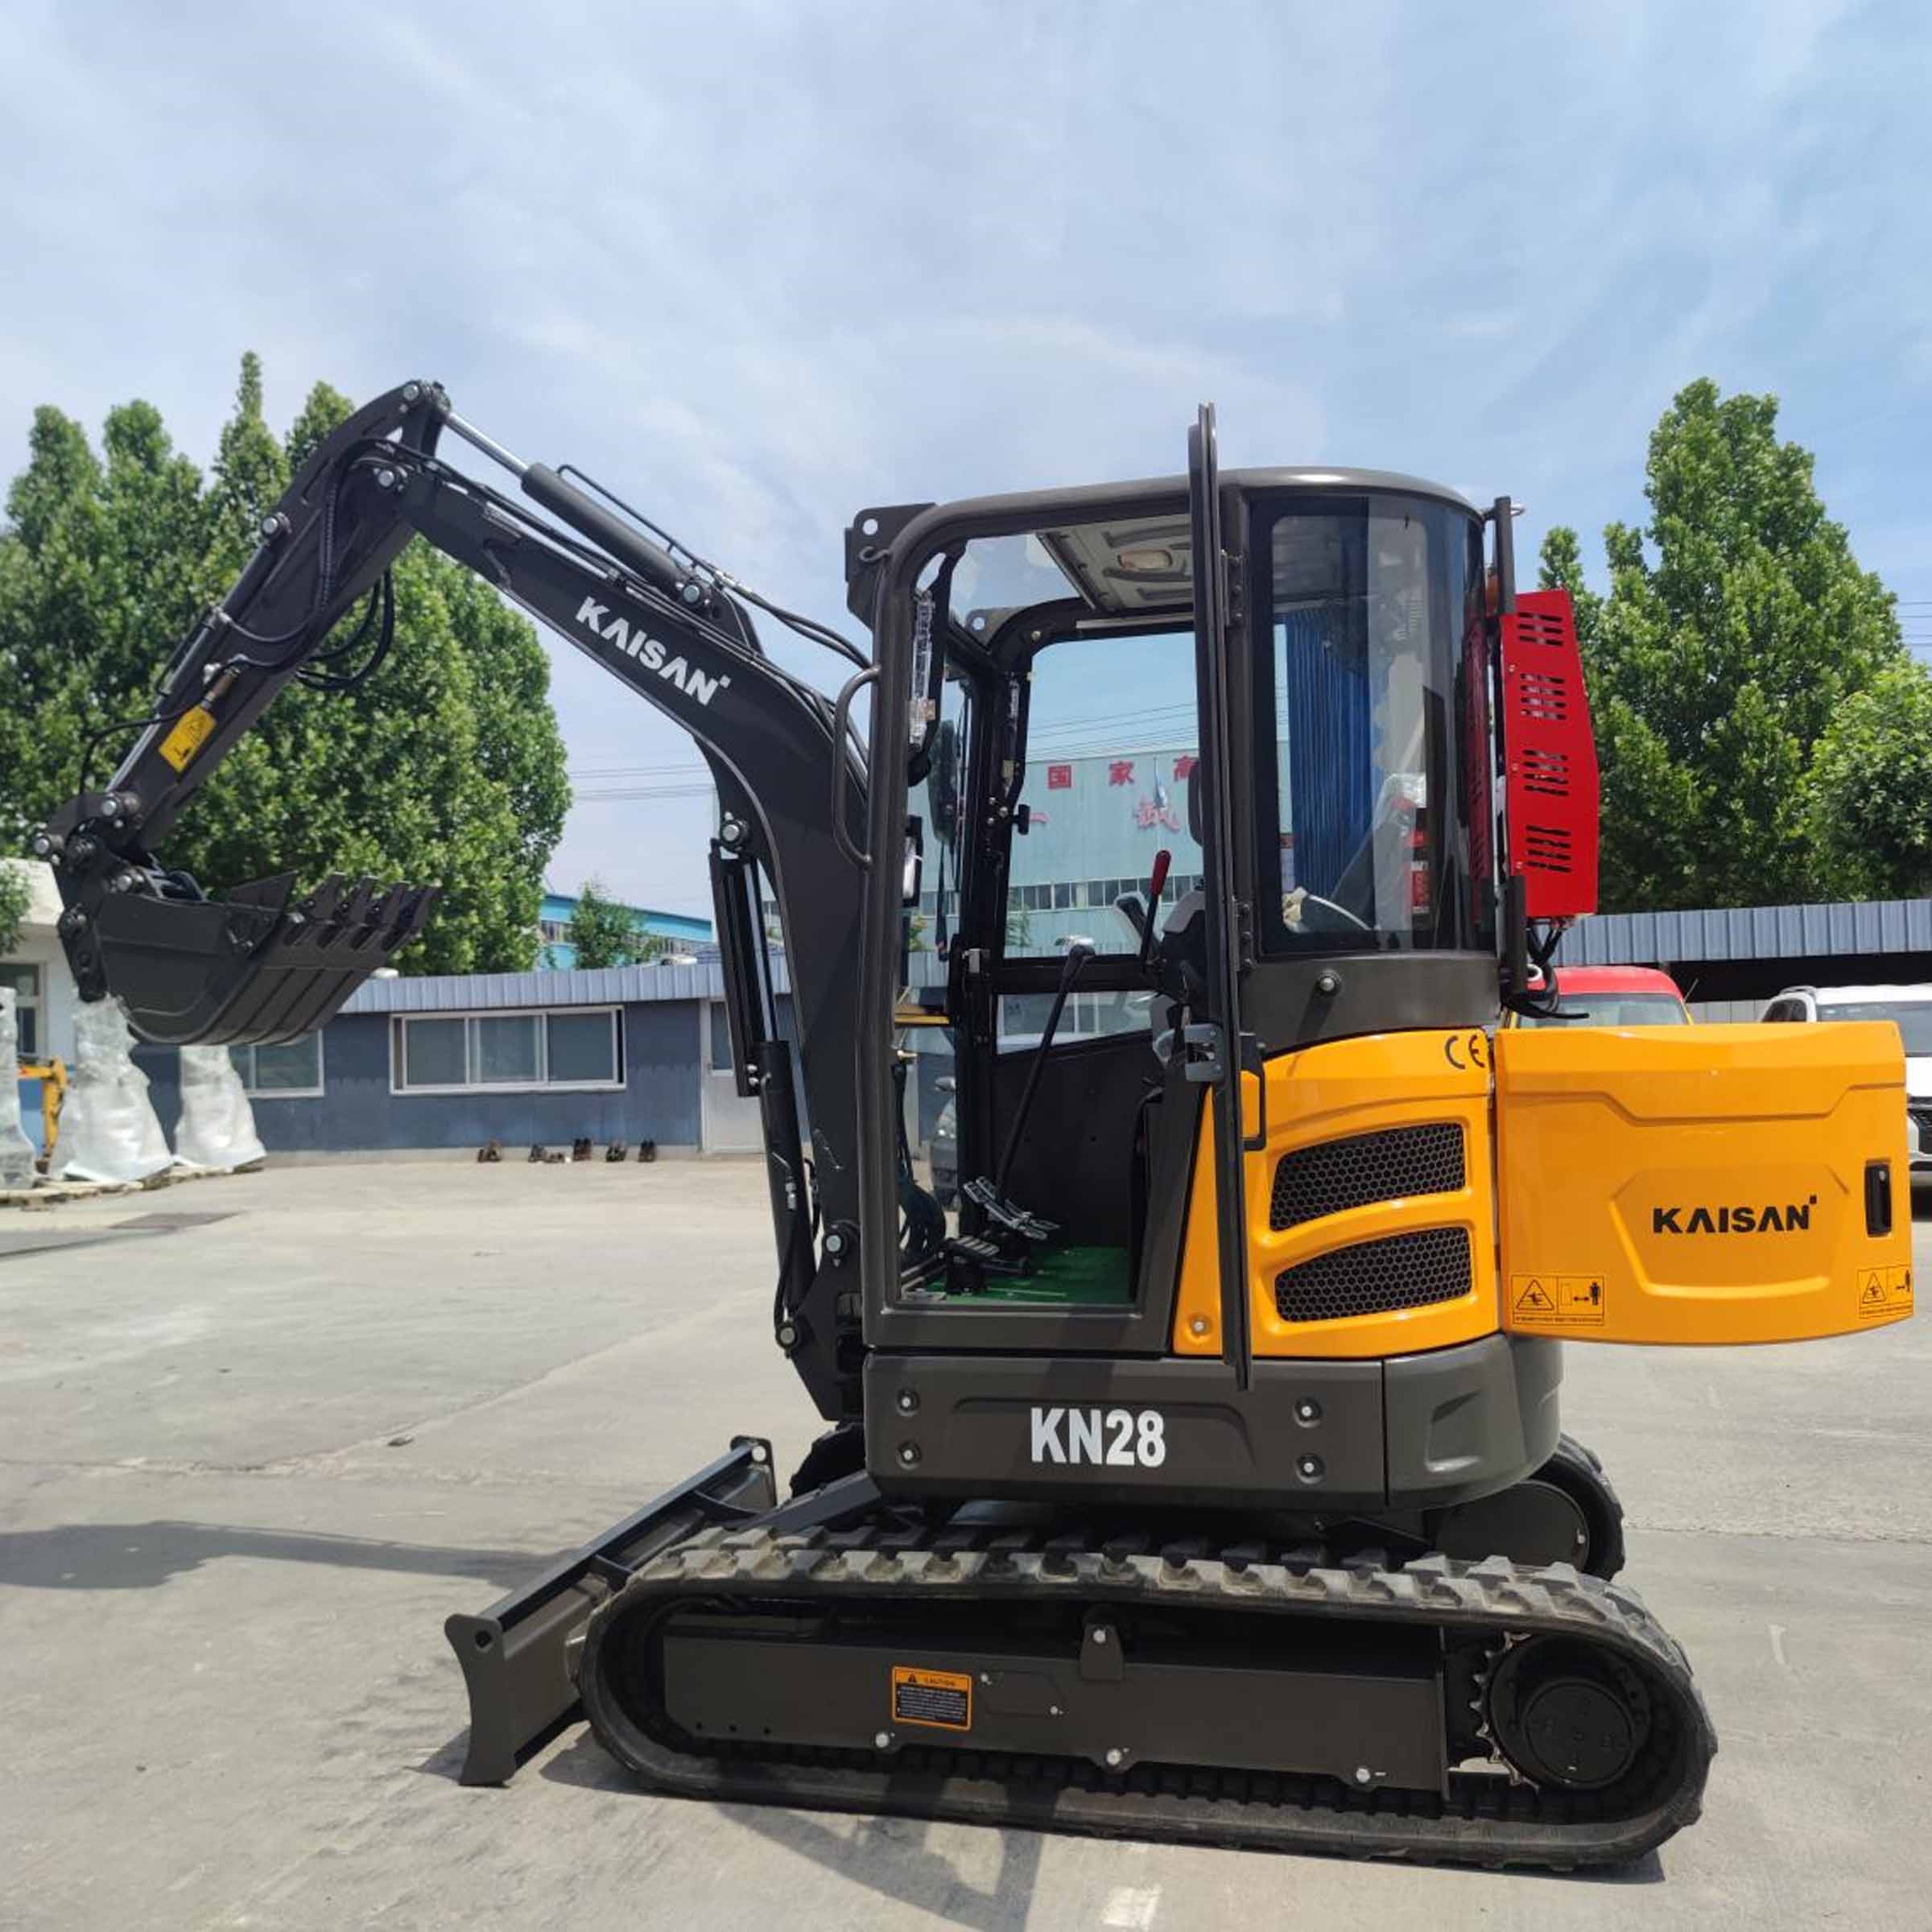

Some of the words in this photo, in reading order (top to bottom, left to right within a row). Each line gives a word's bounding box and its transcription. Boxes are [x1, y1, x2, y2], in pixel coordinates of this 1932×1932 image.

[575, 596, 720, 706] KAISAN
[1653, 1204, 1810, 1234] KAISAN
[1031, 1407, 1166, 1468] KN28
